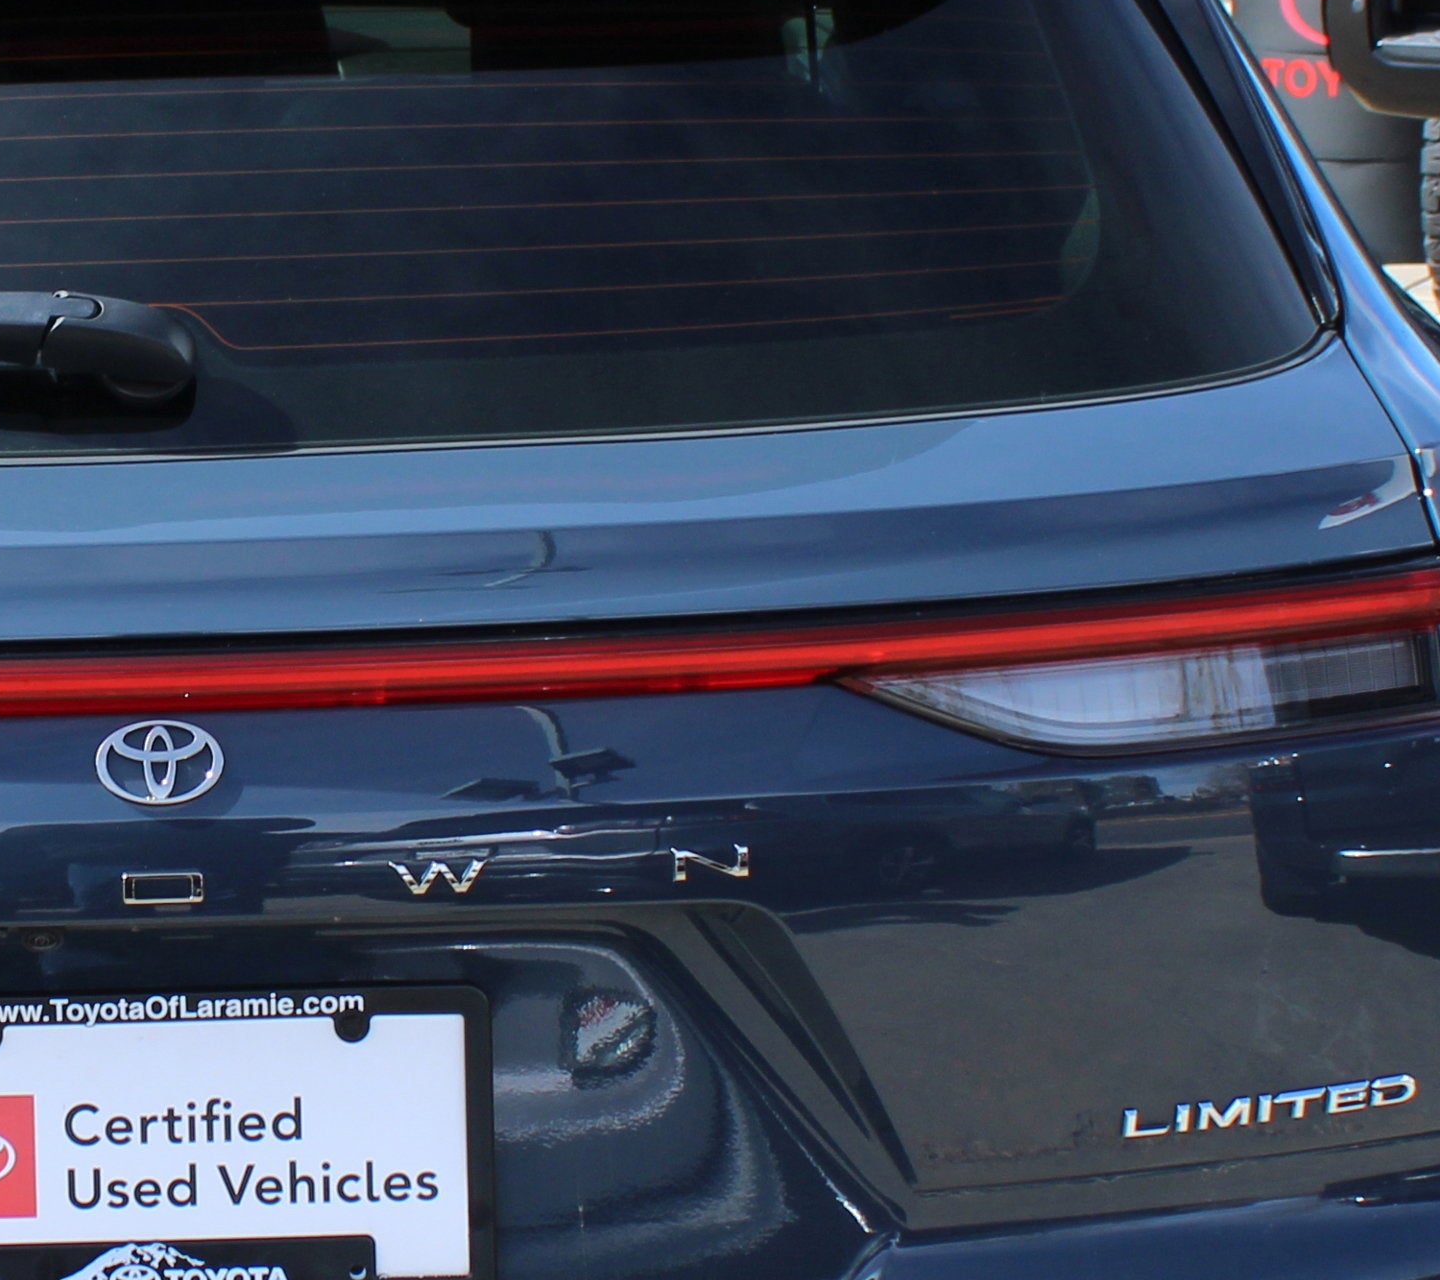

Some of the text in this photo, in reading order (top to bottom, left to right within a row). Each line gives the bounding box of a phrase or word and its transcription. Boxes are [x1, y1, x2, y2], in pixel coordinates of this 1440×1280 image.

[63, 1095, 305, 1147] Certified
[1123, 1072, 1417, 1139] LIMITED
[66, 1160, 440, 1209] Used Vehicles
